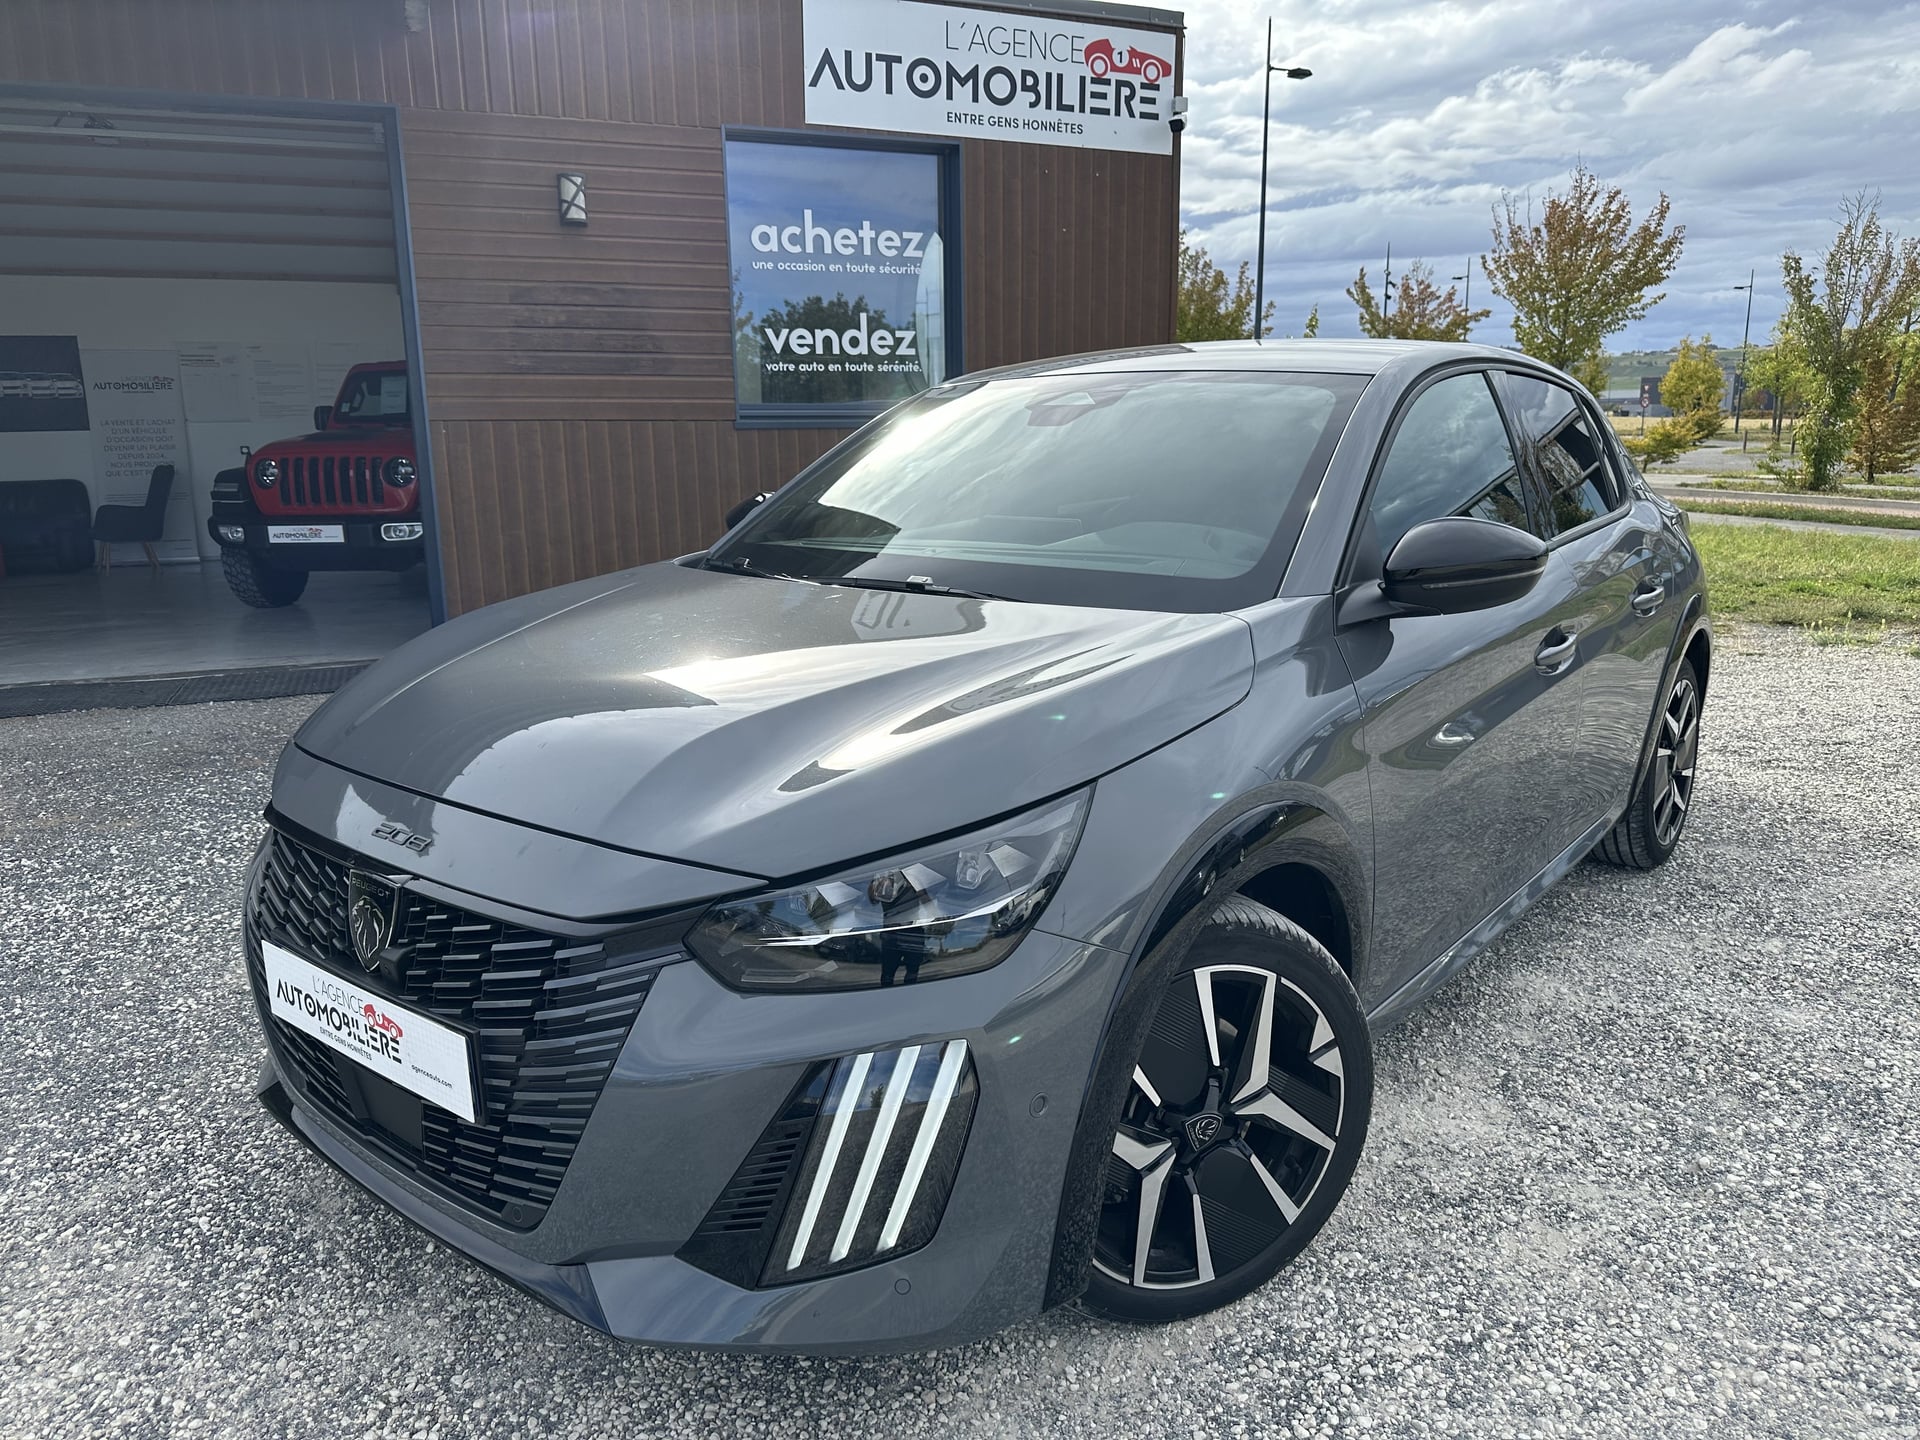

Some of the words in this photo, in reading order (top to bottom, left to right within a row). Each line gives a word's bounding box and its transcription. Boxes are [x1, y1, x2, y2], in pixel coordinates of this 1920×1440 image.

[945, 20, 1085, 65] L'AGENCE
[1116, 50, 1124, 64] 1
[946, 112, 985, 126] ENTRE
[987, 115, 1020, 130] GENS
[1022, 118, 1084, 135] HONNÊTES
[751, 208, 924, 258] achetez
[752, 261, 774, 270] une
[777, 259, 826, 272] occasion
[829, 263, 843, 273] en
[846, 262, 876, 274] toute
[764, 312, 916, 356] vendez
[766, 362, 796, 372] votre
[798, 362, 825, 372] auto
[828, 363, 842, 372] en
[845, 362, 875, 373] toute
[877, 361, 923, 373] sérénité.
[371, 822, 433, 852] 208
[312, 975, 366, 1017] L'AGENCE
[319, 1026, 335, 1040] ENTRE
[334, 1033, 347, 1048] GENS
